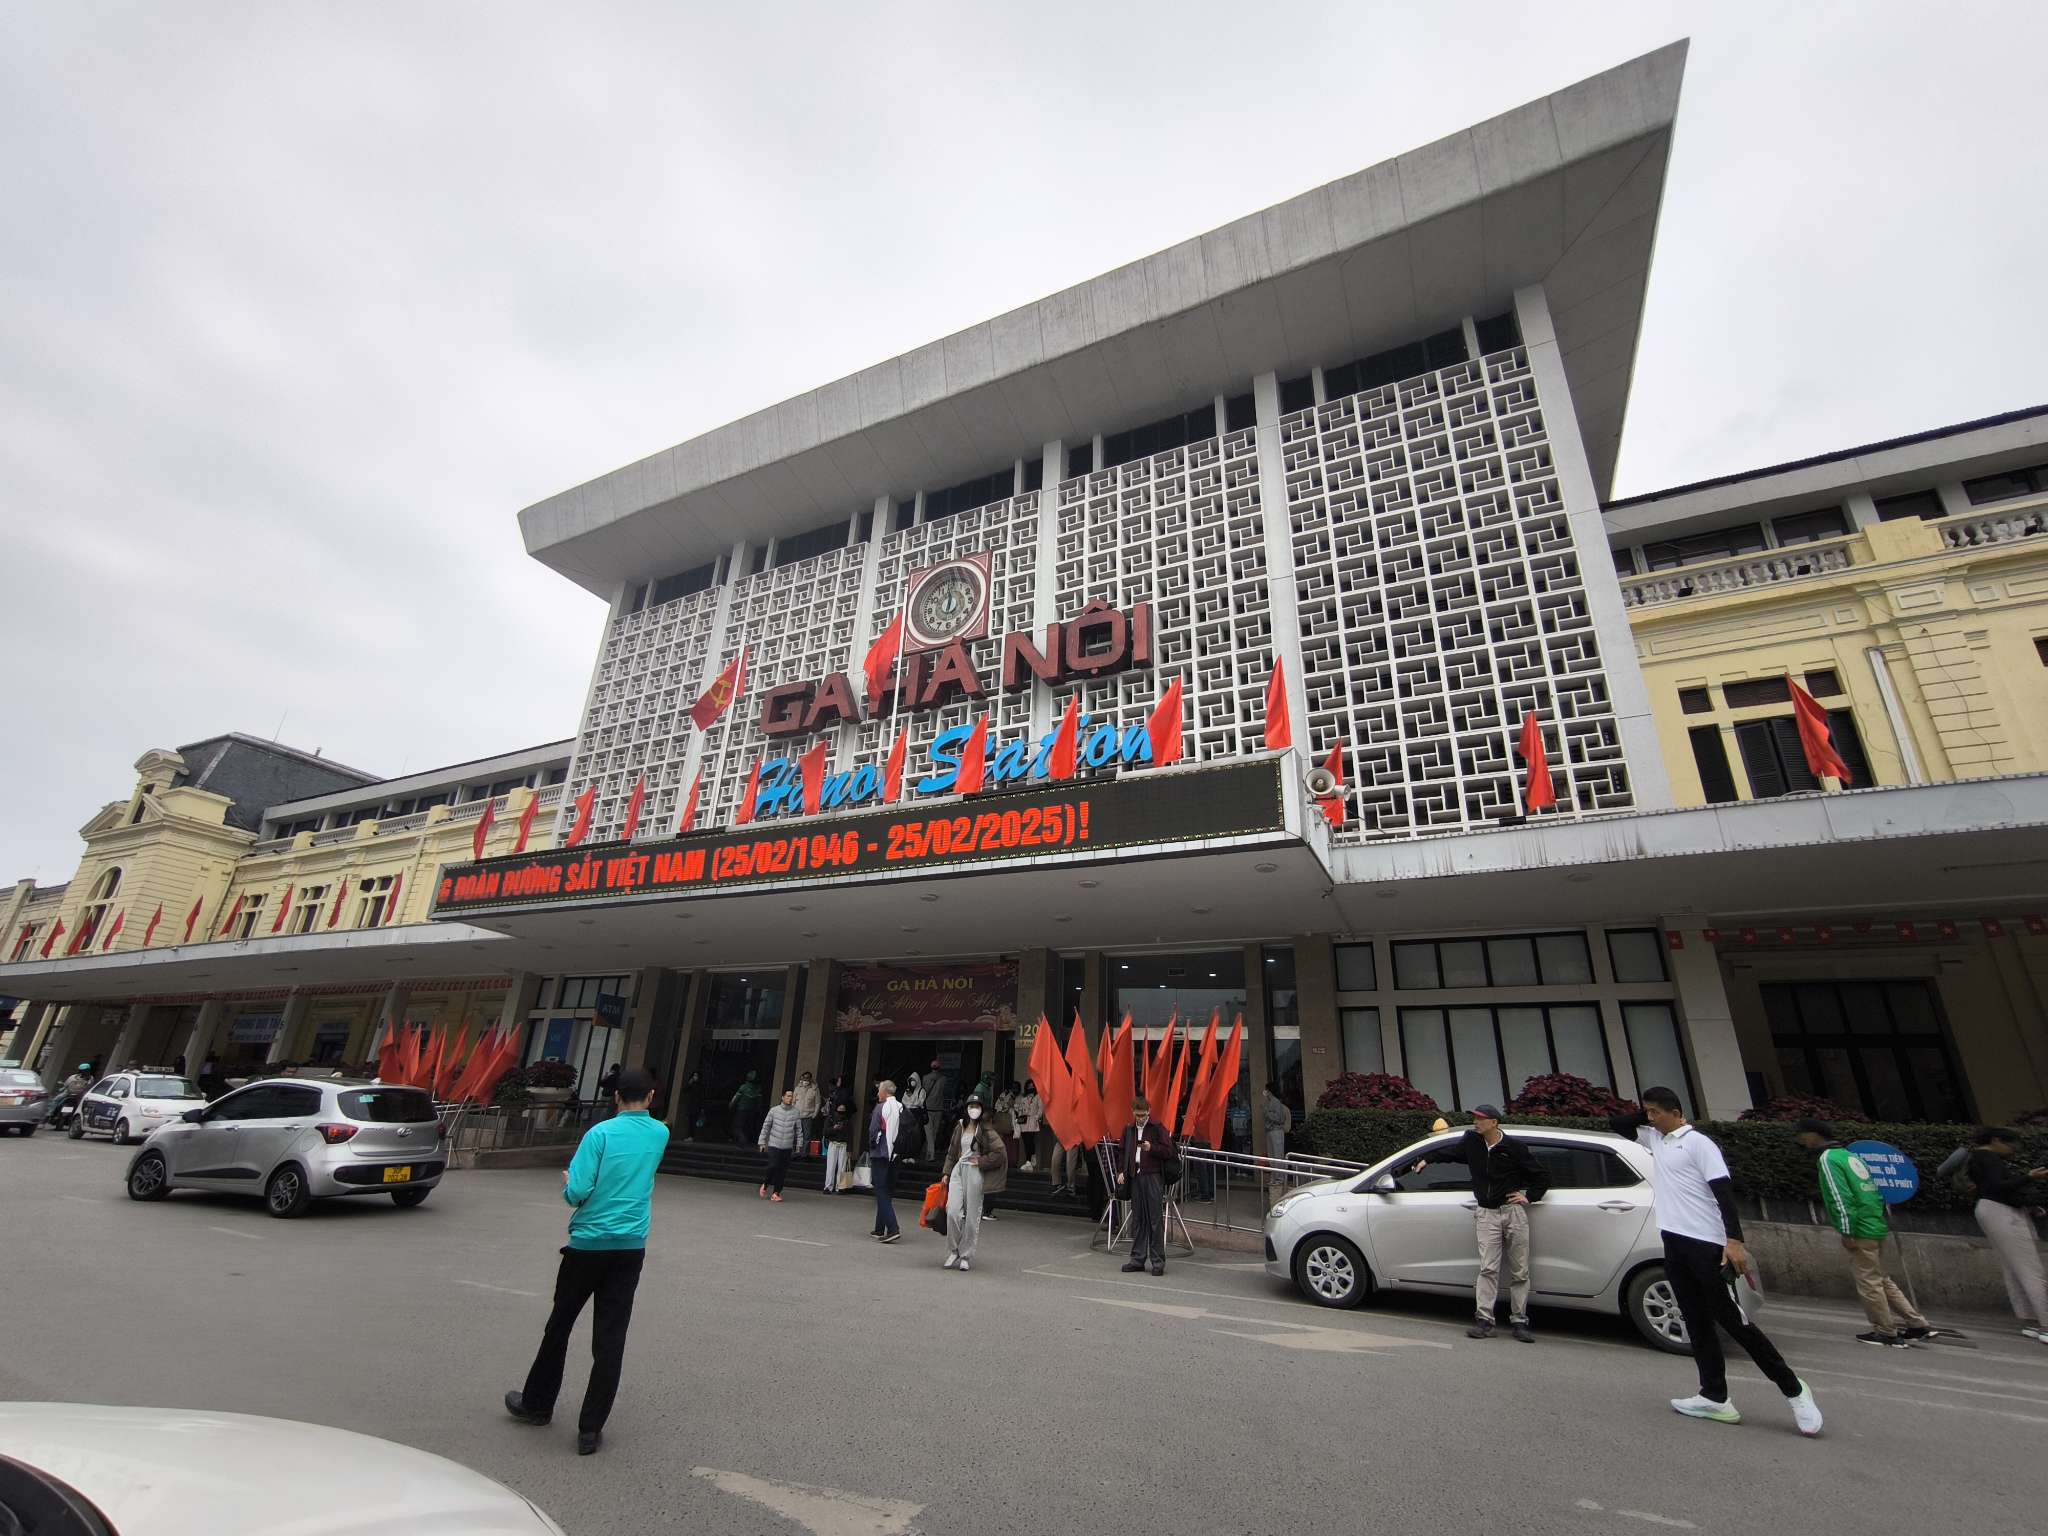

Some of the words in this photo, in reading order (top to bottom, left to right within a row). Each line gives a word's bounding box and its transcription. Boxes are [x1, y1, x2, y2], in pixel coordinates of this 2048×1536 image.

[760, 672, 862, 738] GA
[868, 636, 987, 720] HÀ
[1003, 598, 1154, 694] NỘI
[918, 713, 1153, 793] Sation
[454, 868, 500, 900] ĐOÀN
[502, 861, 563, 897] ĐƯỜNG
[565, 852, 603, 892] SẮT
[606, 851, 650, 895] VIỆT
[653, 849, 706, 884] NAM
[712, 830, 859, 881] (25/02/1946
[887, 802, 1090, 861] 25/02/2025)!
[886, 979, 912, 992] GA
[914, 977, 938, 991] HÀ
[602, 1004, 621, 1016] ATM
[1018, 1024, 1040, 1037] 120
